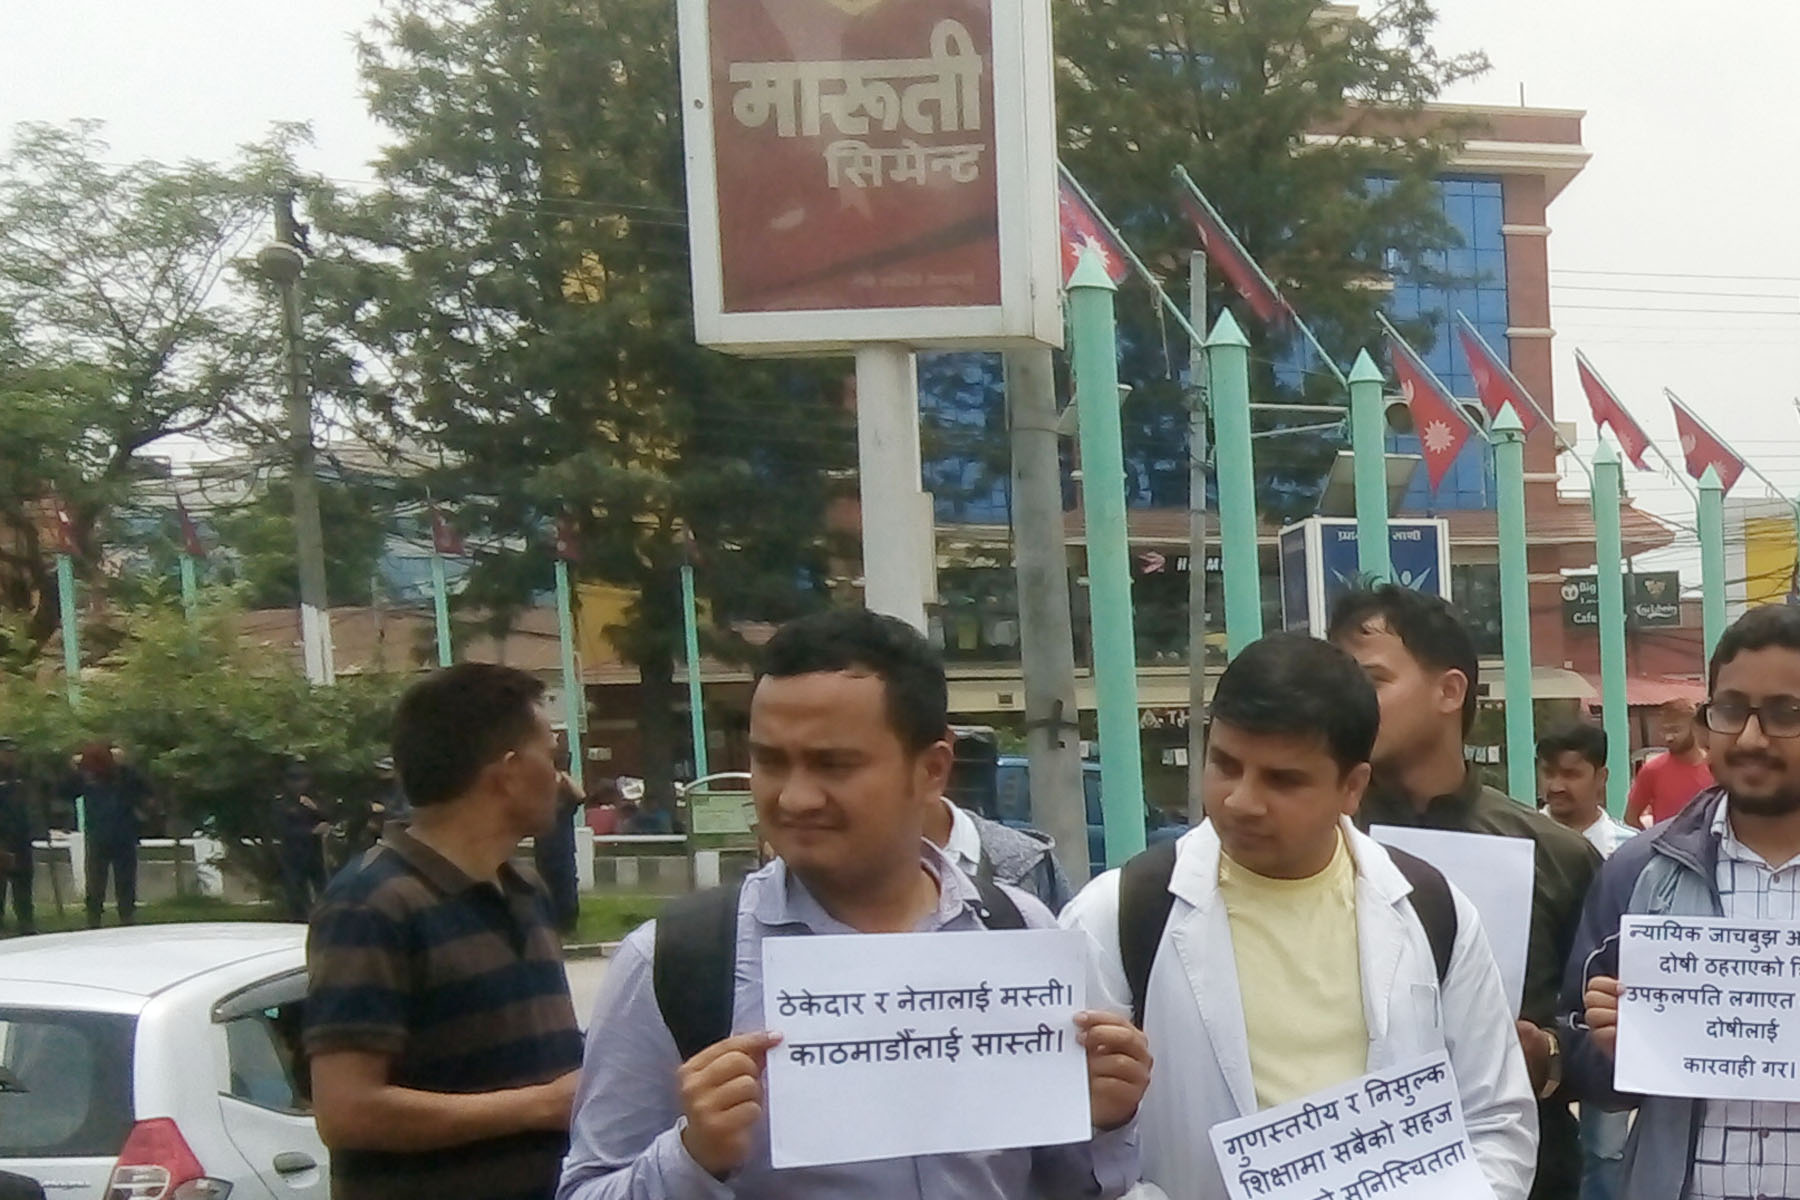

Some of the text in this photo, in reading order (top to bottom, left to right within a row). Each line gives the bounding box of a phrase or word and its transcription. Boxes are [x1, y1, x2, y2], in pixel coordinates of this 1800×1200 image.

[823, 139, 985, 188] सिमेन्ट
[1629, 920, 1703, 942] न्यायिक
[1708, 926, 1778, 954] जाचबुझ
[1660, 951, 1698, 975] दोषी
[1704, 956, 1785, 979] ठहराएको
[776, 978, 1074, 1018] ठेकेदार र नेतालाई मस्ती।
[1626, 983, 1723, 1013] उपकुलपति
[1728, 988, 1796, 1010] लगाएत
[970, 1024, 1064, 1056] सास्ती।
[1706, 1016, 1780, 1044] दोषीलाई
[1683, 1056, 1796, 1080] कारवाही गर।
[1223, 1061, 1446, 1168] गुणस्तरीय र निसुल्क
[1239, 1100, 1454, 1200] शिक्षामा सबैको सहज
